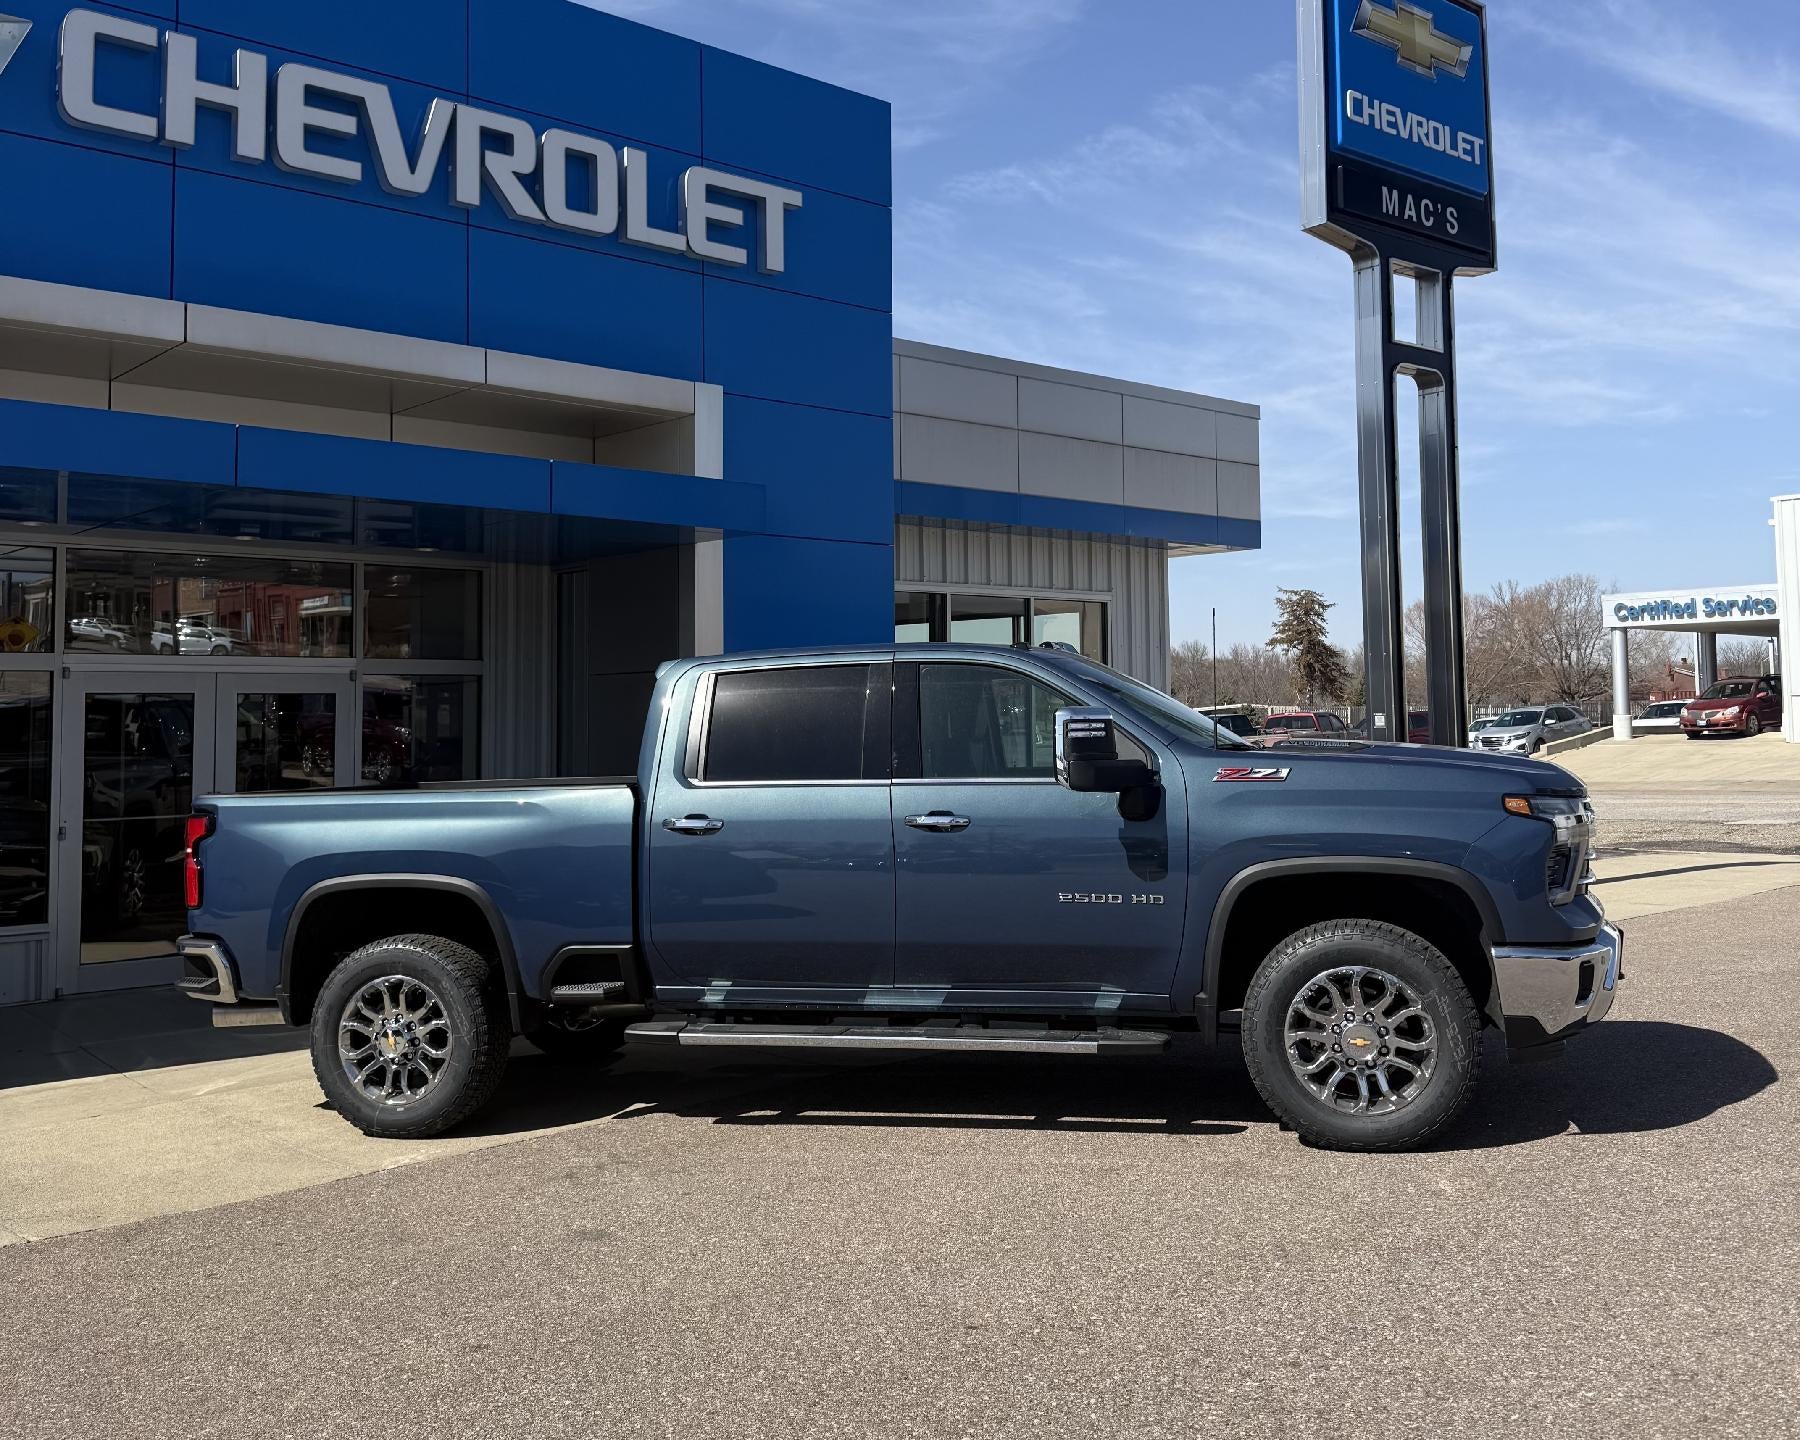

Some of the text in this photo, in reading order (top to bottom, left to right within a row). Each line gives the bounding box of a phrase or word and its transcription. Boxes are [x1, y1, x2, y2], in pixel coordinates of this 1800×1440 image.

[57, 8, 802, 274] CHEVROLET
[1346, 89, 1484, 165] CHEVROLET
[1381, 186, 1459, 235] MAC'S
[1613, 595, 1777, 622] Certified Service
[1212, 767, 1292, 782] Z71
[1058, 892, 1165, 905] 2500 HD
